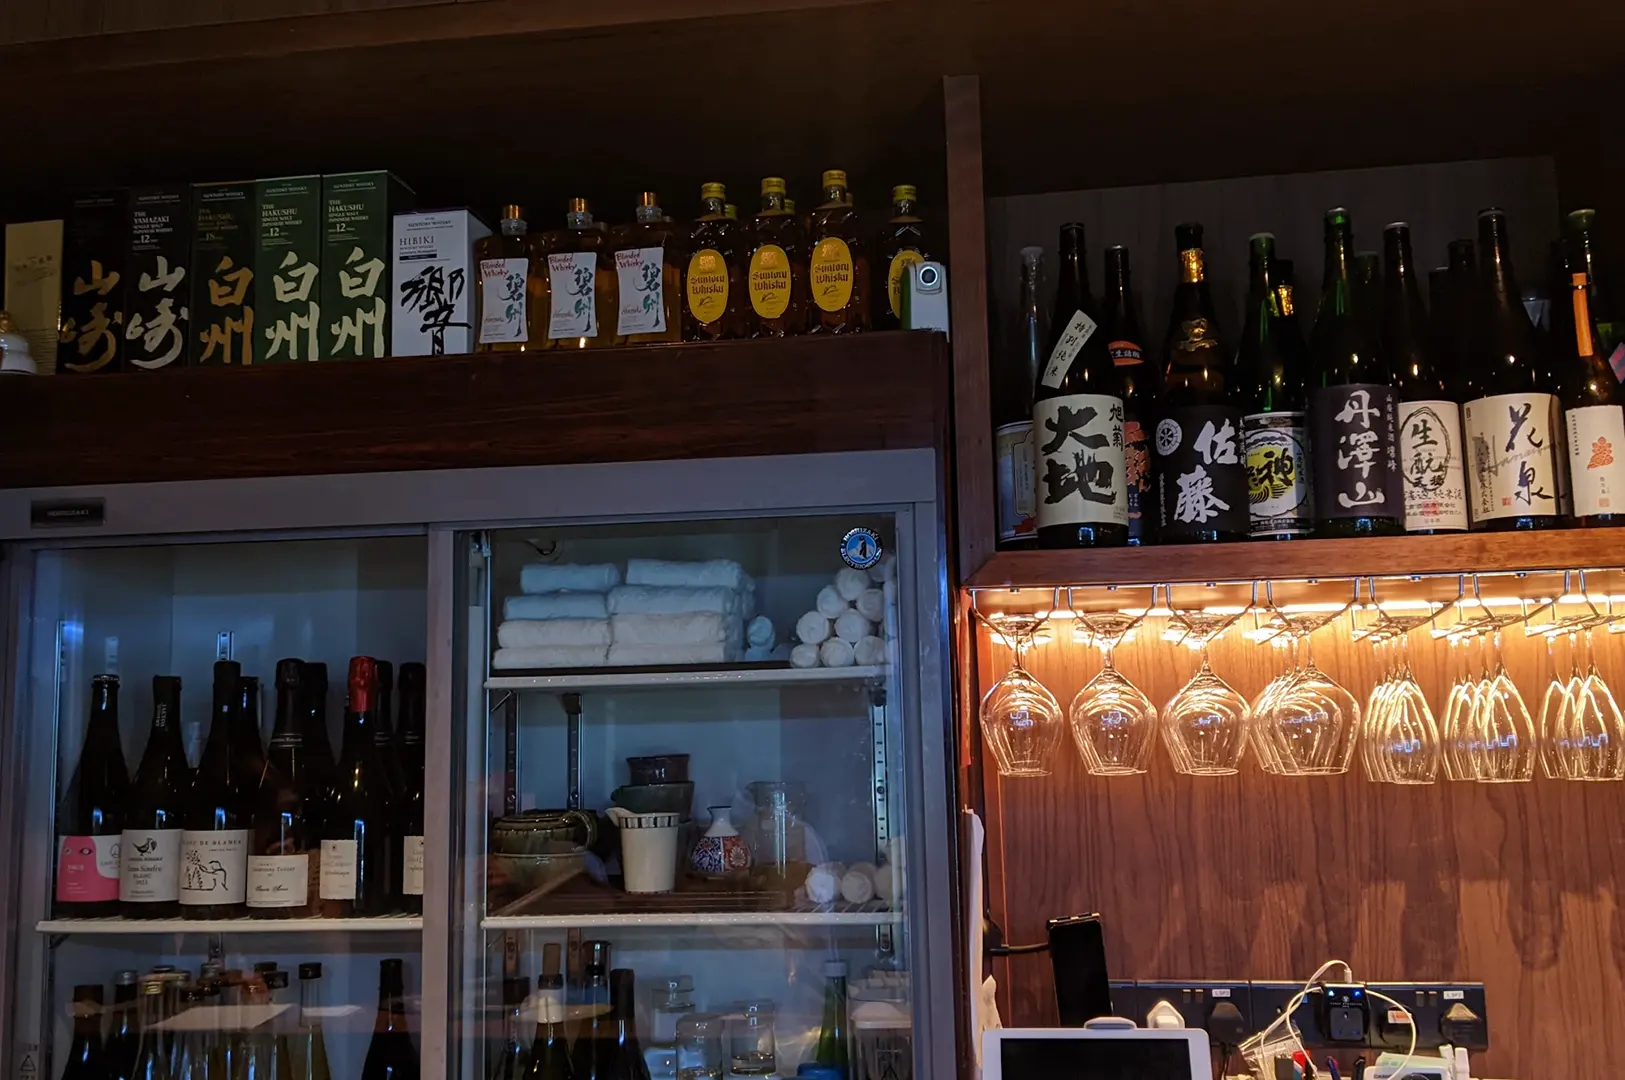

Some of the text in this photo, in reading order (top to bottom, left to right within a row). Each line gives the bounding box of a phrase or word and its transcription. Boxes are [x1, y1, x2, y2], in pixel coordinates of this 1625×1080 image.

[261, 208, 297, 217] HAKUSHU
[328, 203, 364, 213] HAKUSHU
[133, 215, 169, 224] YAMAZAKI
[269, 227, 280, 236] 12
[336, 222, 346, 232] 12
[140, 234, 151, 243] 12
[399, 235, 434, 246] HIBIKI
[549, 255, 573, 264] Blended
[616, 251, 641, 261] Blended
[482, 260, 505, 270] Blended
[551, 264, 577, 274] Whisky
[618, 260, 645, 269] Whisky
[814, 262, 849, 274] Suntory
[484, 269, 509, 278] Whisky
[752, 270, 788, 282] Suntory
[815, 273, 849, 285] Whisky
[690, 274, 725, 286] Suntory
[753, 279, 787, 292] Whisky
[692, 284, 724, 295] Whisky
[265, 250, 320, 362] 白州
[331, 246, 386, 359] 白州
[60, 259, 123, 373] 山崎
[126, 256, 189, 370] 山崎
[200, 255, 255, 366] 白州
[1334, 389, 1385, 509] 丹澤山
[1041, 405, 1117, 505] 大地
[1174, 418, 1238, 524] 佐藤
